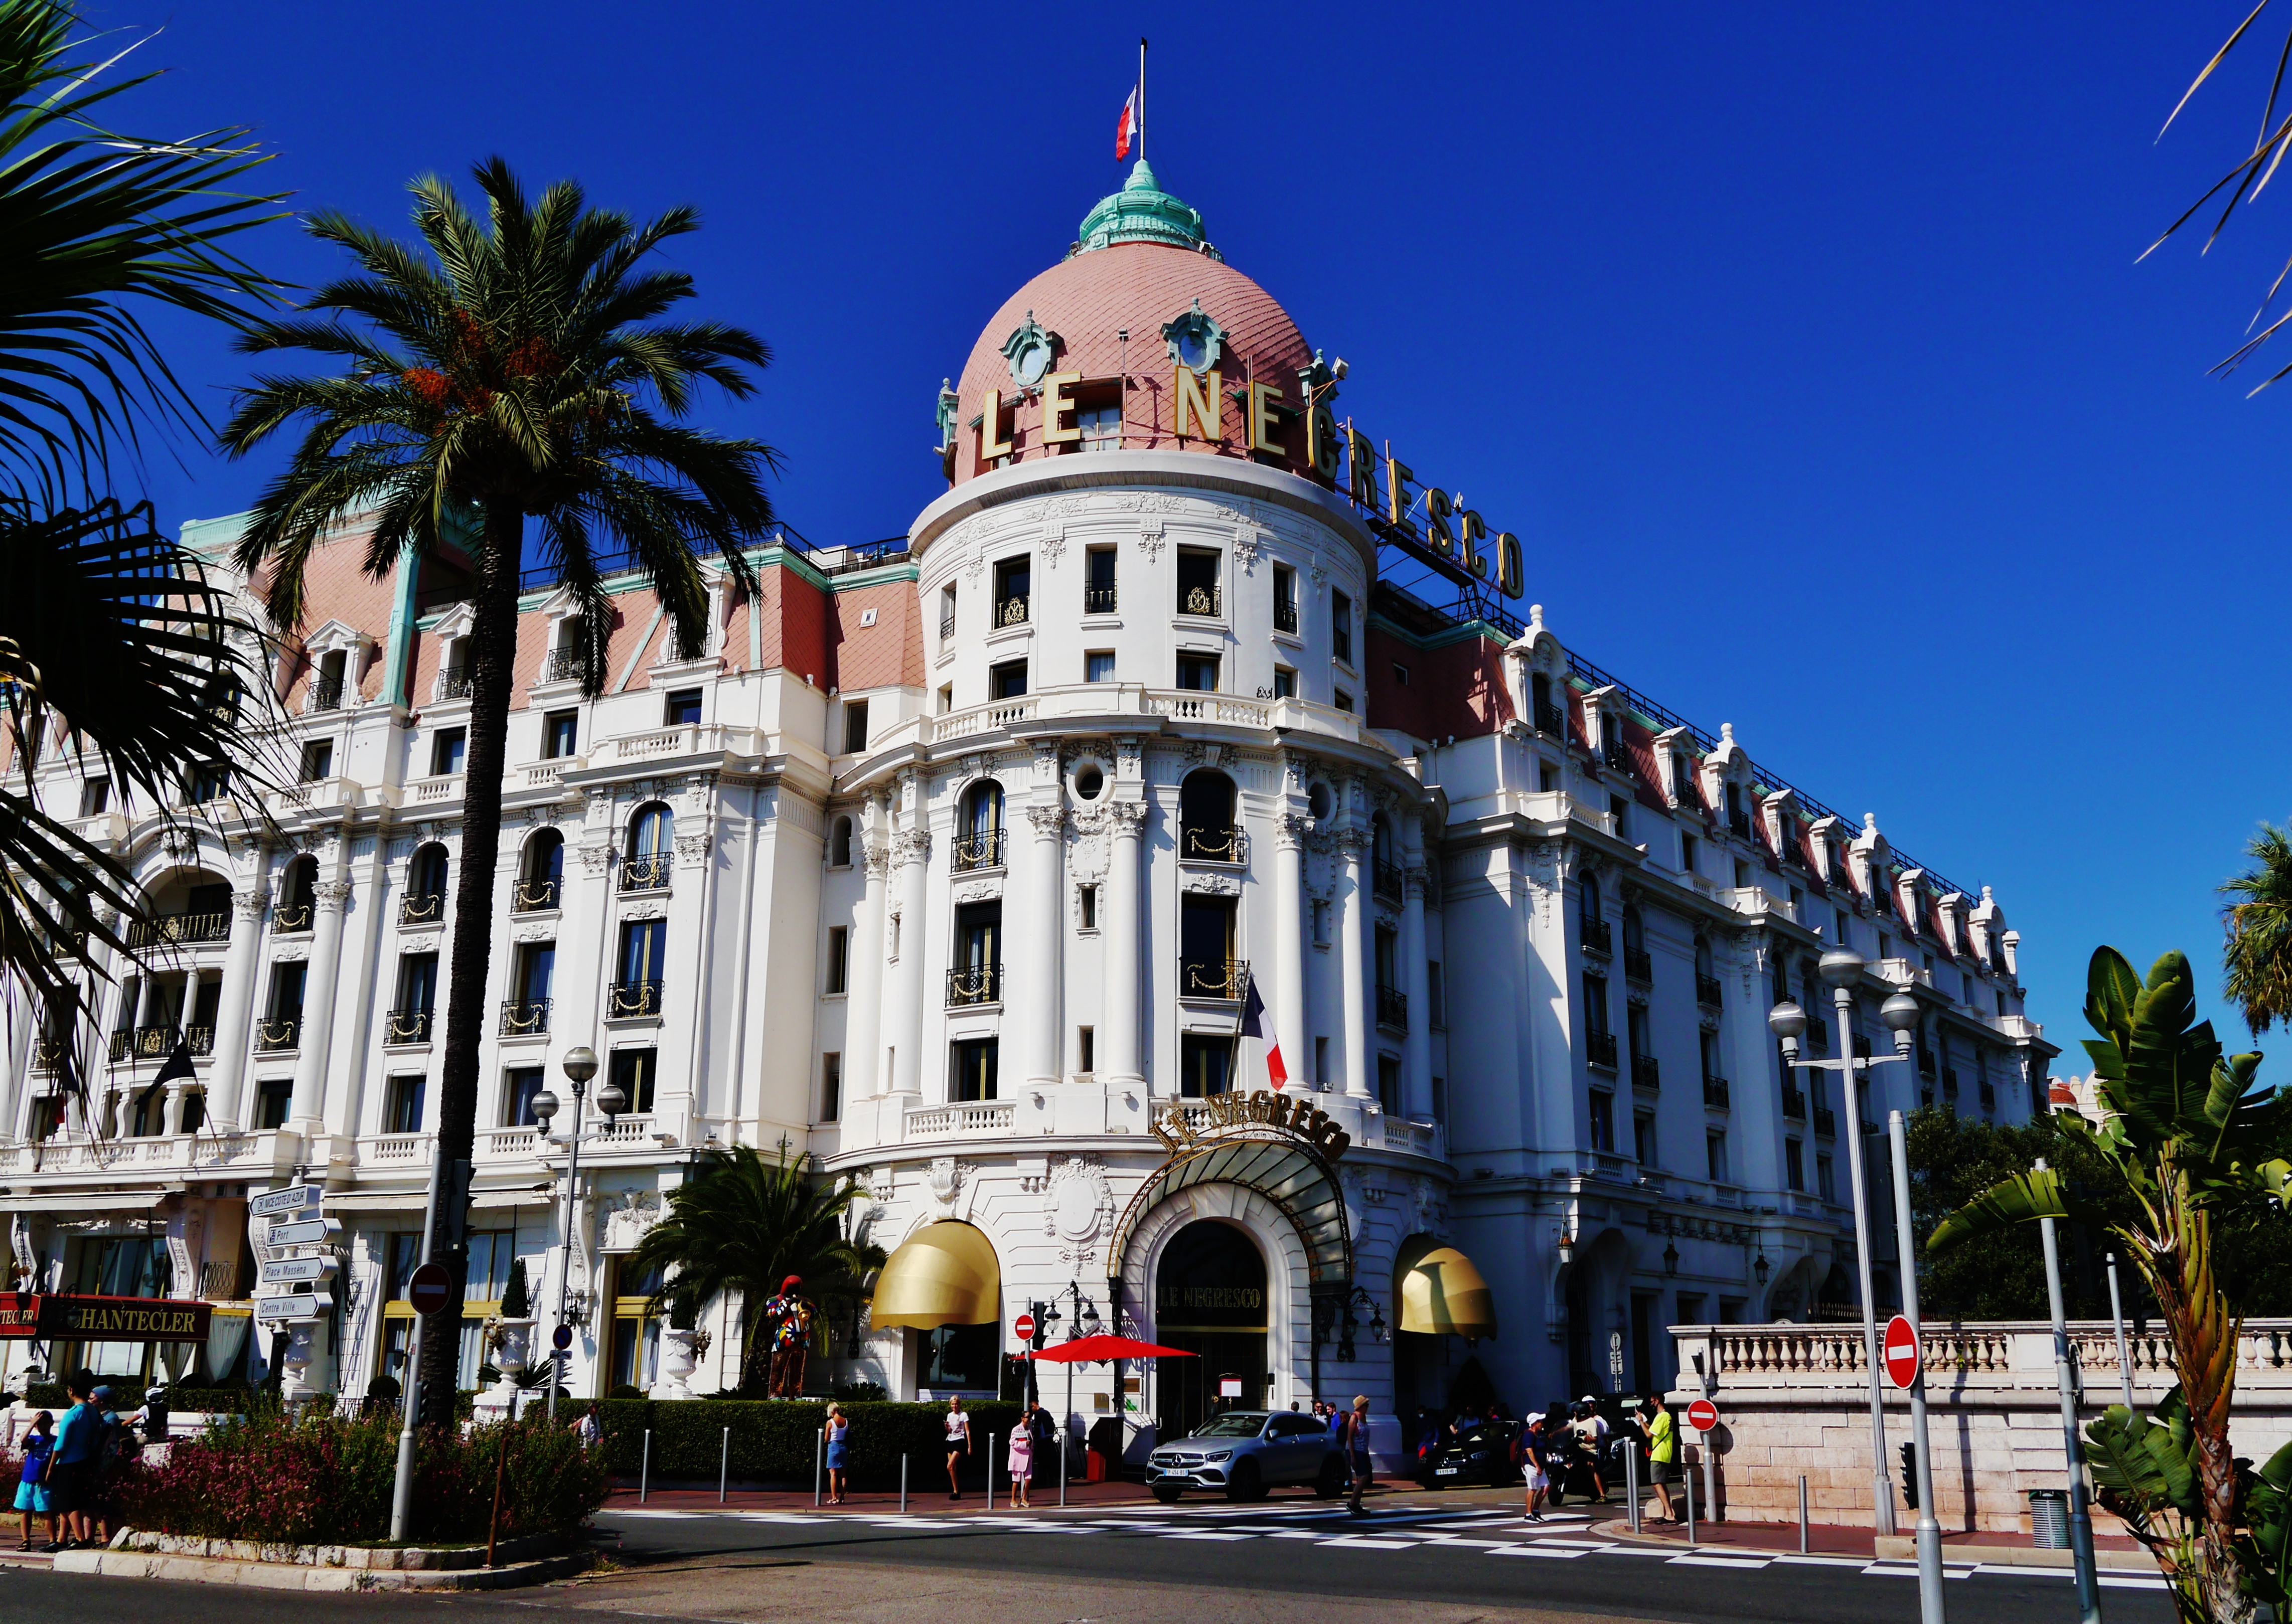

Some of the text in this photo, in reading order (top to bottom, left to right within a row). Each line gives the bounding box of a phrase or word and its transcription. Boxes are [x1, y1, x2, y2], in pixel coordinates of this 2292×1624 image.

[982, 365, 1524, 600] LE NEGRESCO
[1149, 1089, 1351, 1161] LE NEGRESCO
[264, 1197, 275, 1209] NICE
[275, 1195, 287, 1207] COTE
[276, 1230, 289, 1240] Port
[265, 1264, 307, 1277] Place Masséna
[1160, 1287, 1261, 1308] LE NEGRESCO
[261, 1301, 295, 1314] Centre Ville
[0, 1310, 34, 1325] TECLER
